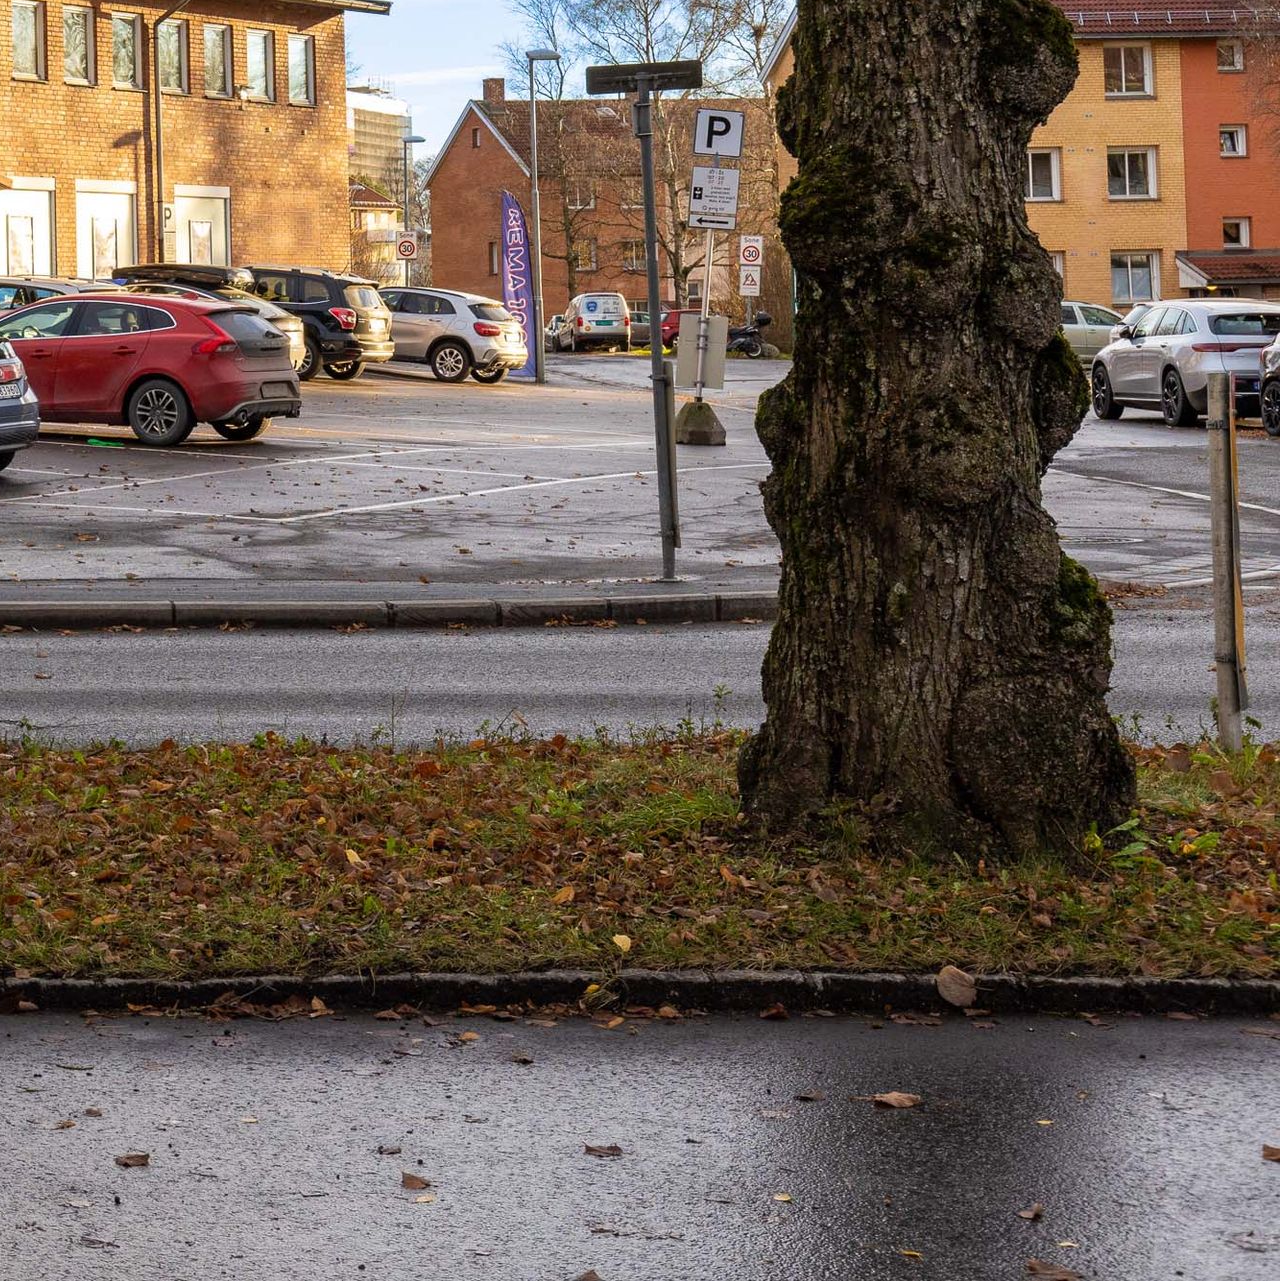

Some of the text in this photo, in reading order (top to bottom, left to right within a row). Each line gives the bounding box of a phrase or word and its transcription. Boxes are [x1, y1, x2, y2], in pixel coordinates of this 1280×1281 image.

[706, 115, 731, 148] P
[401, 244, 412, 253] 30
[745, 249, 757, 258] 30
